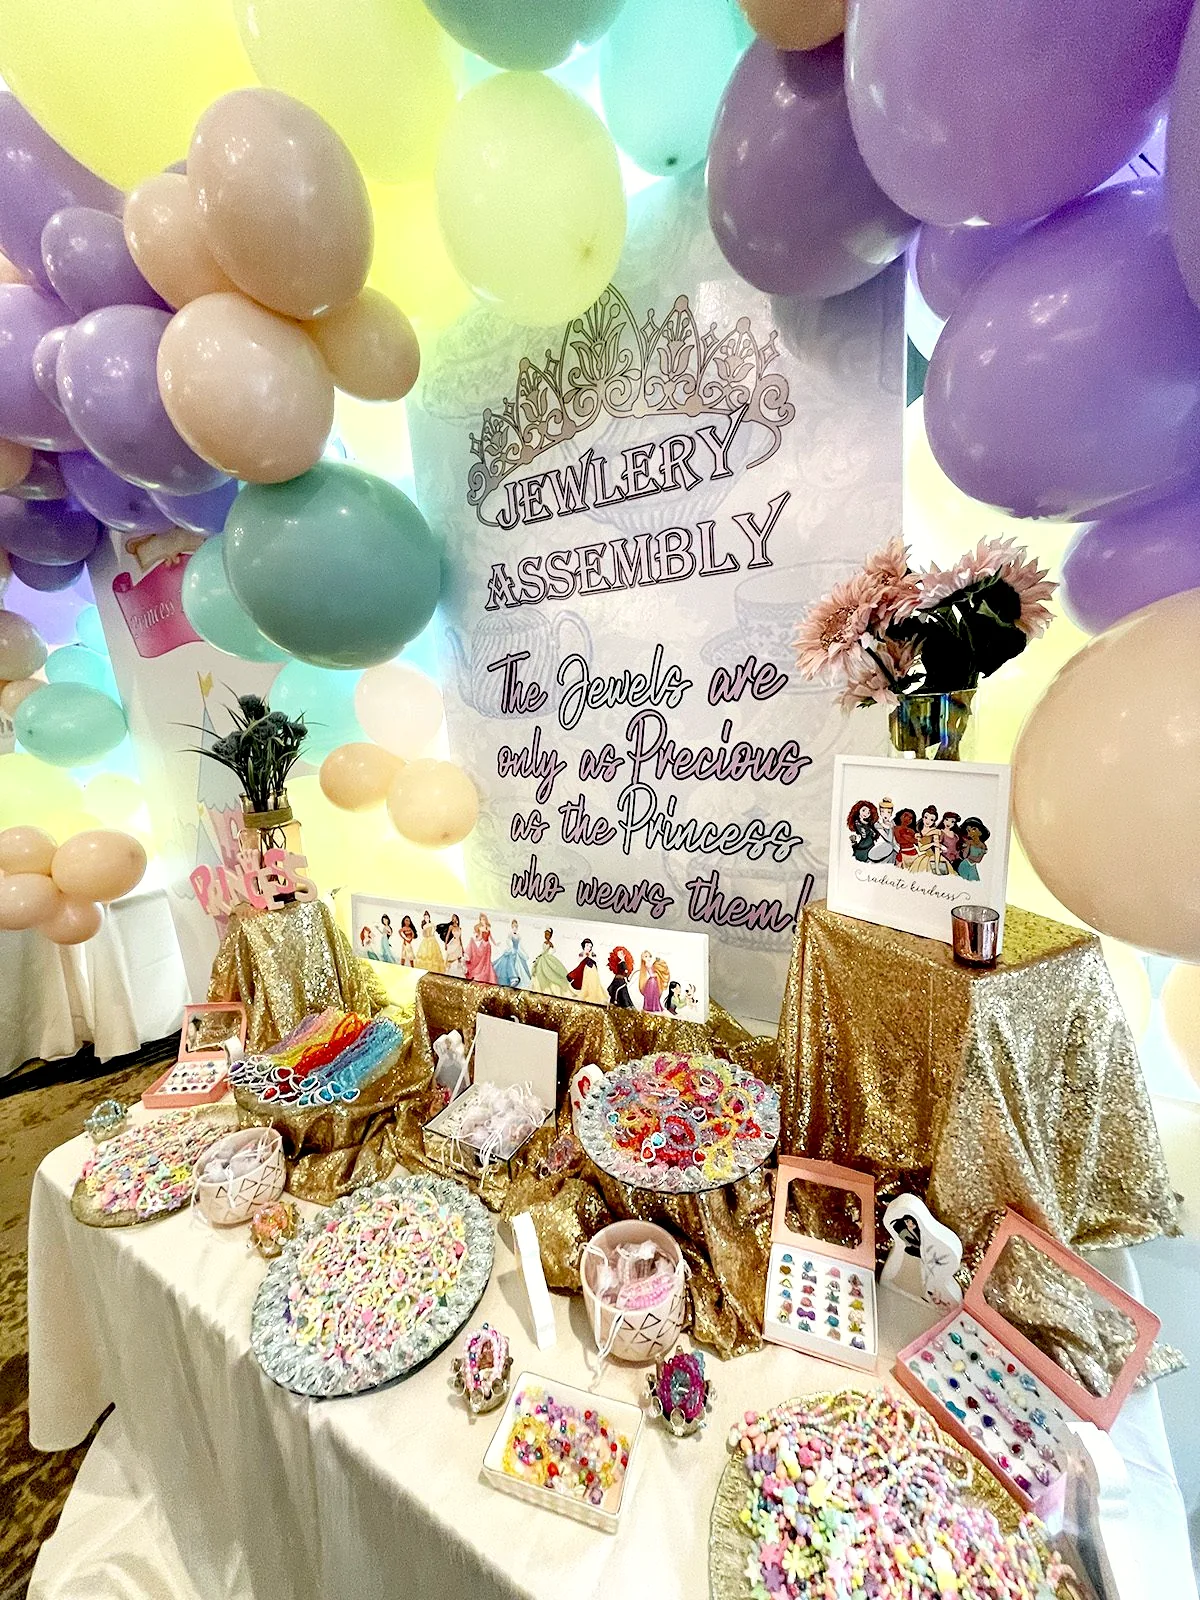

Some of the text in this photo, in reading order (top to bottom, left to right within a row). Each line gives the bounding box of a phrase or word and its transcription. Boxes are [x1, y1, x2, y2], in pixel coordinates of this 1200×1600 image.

[496, 403, 750, 530] JEWLERY
[484, 491, 791, 611] ASSEMBLY
[487, 644, 788, 730] The Jewels are
[497, 709, 812, 804] only as Precious
[510, 782, 803, 862] as the Princess
[510, 854, 815, 934] who wears them!
[855, 868, 972, 901] radiate kindness
